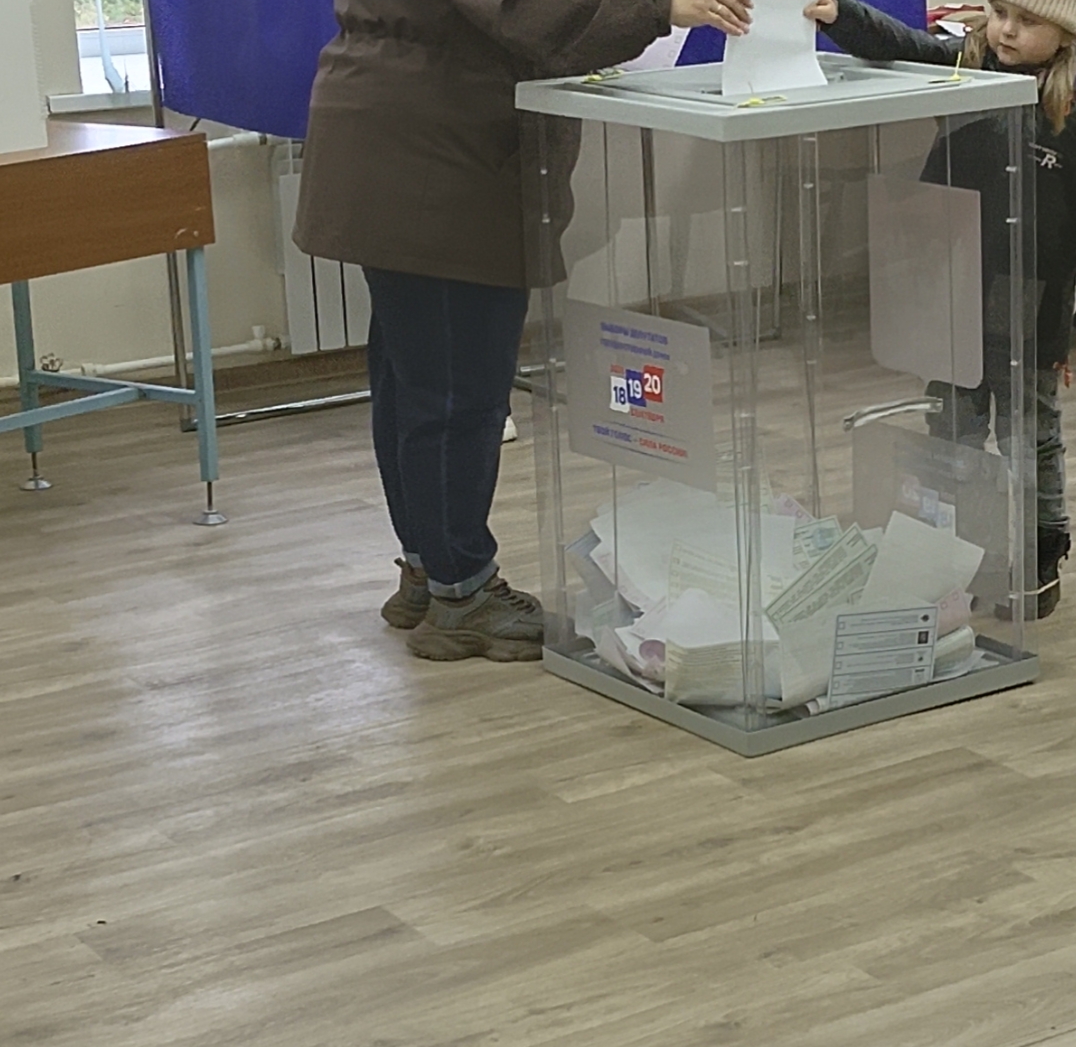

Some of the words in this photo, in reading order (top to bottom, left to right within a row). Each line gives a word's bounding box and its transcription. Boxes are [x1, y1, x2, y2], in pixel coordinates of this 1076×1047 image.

[613, 385, 627, 406] 18
[628, 378, 643, 400] 19
[643, 372, 661, 395] 20
